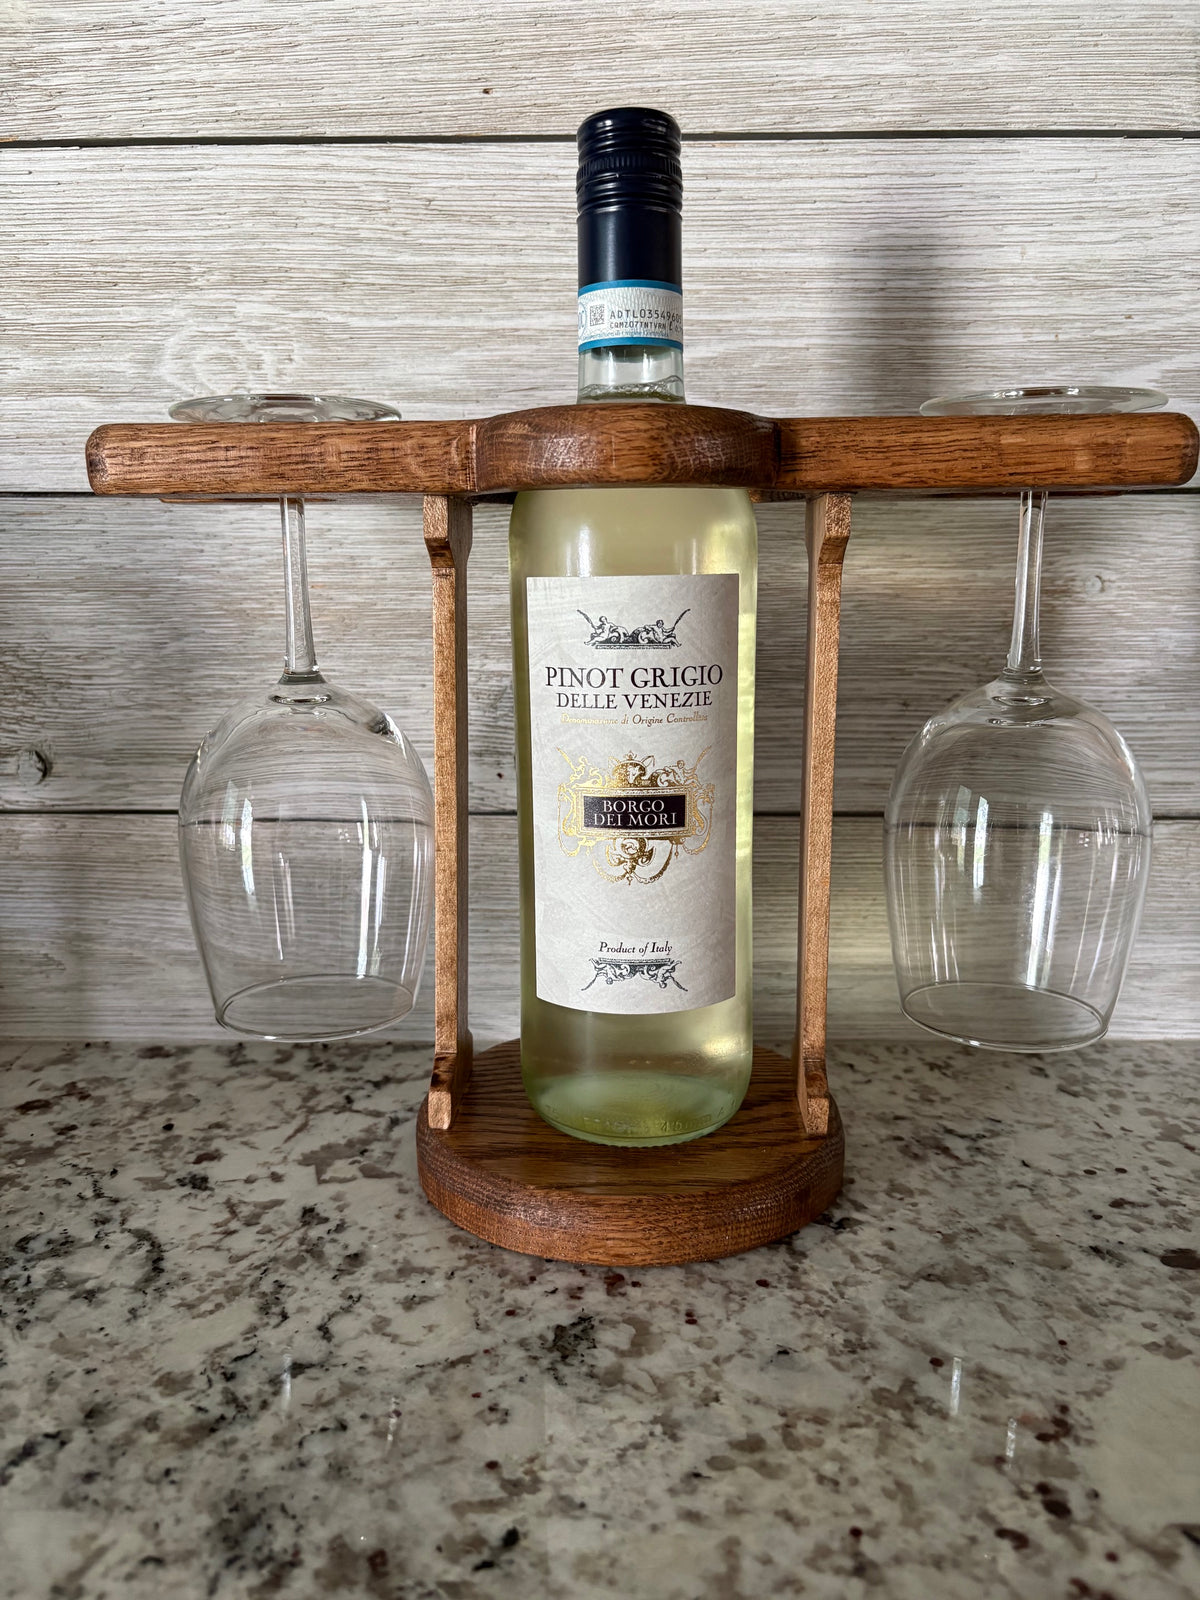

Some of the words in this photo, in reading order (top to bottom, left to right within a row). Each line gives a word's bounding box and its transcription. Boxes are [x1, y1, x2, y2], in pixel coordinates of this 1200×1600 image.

[545, 666, 623, 688] PINOT
[630, 664, 723, 688] GRIGIO
[556, 692, 617, 709] DELLE
[622, 690, 713, 709] VENEZIE
[621, 713, 629, 724] di
[632, 714, 663, 727] Origine
[603, 799, 665, 813] BORGO
[594, 813, 623, 827] DEI
[628, 812, 678, 827] MORI
[599, 941, 635, 953] Product
[638, 942, 649, 957] of
[651, 941, 673, 955] Italy
